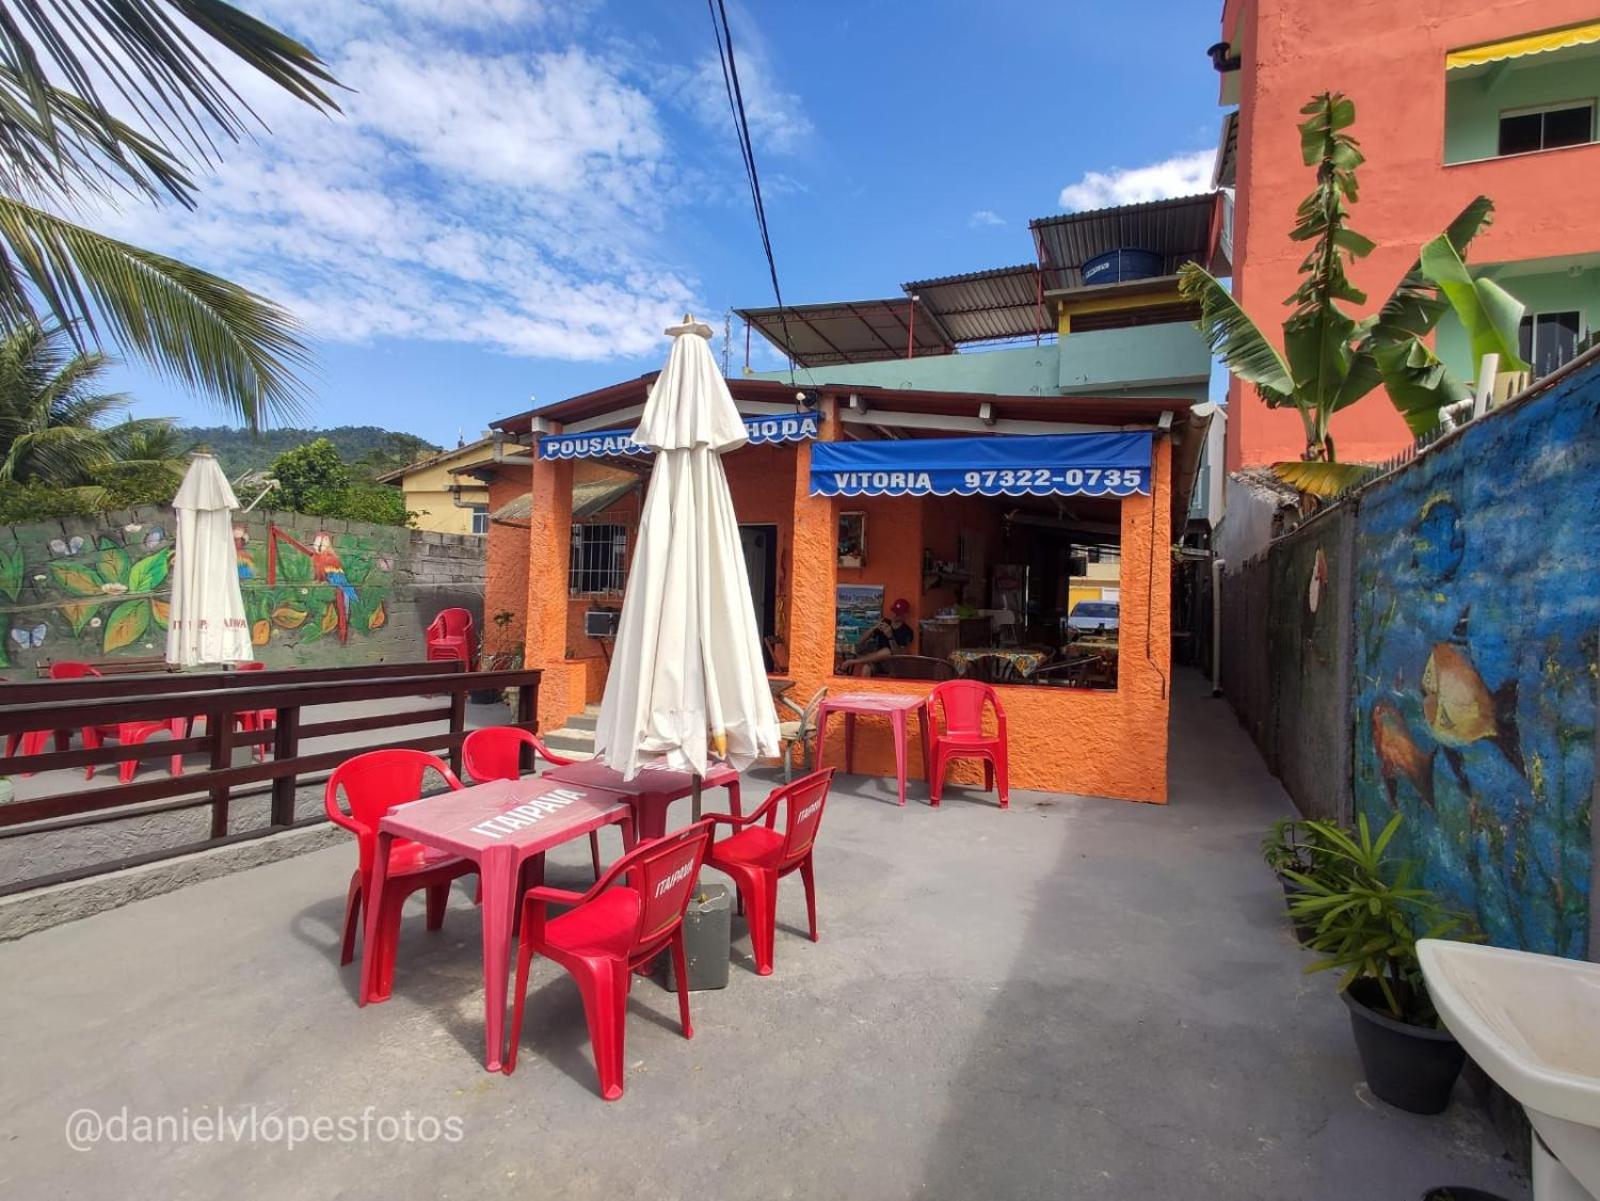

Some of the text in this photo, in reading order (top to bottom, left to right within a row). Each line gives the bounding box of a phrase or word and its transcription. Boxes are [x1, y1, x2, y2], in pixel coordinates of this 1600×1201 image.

[833, 468, 1142, 489] VITORIA 97322-0735
[469, 788, 588, 839] ITAIPAVA
